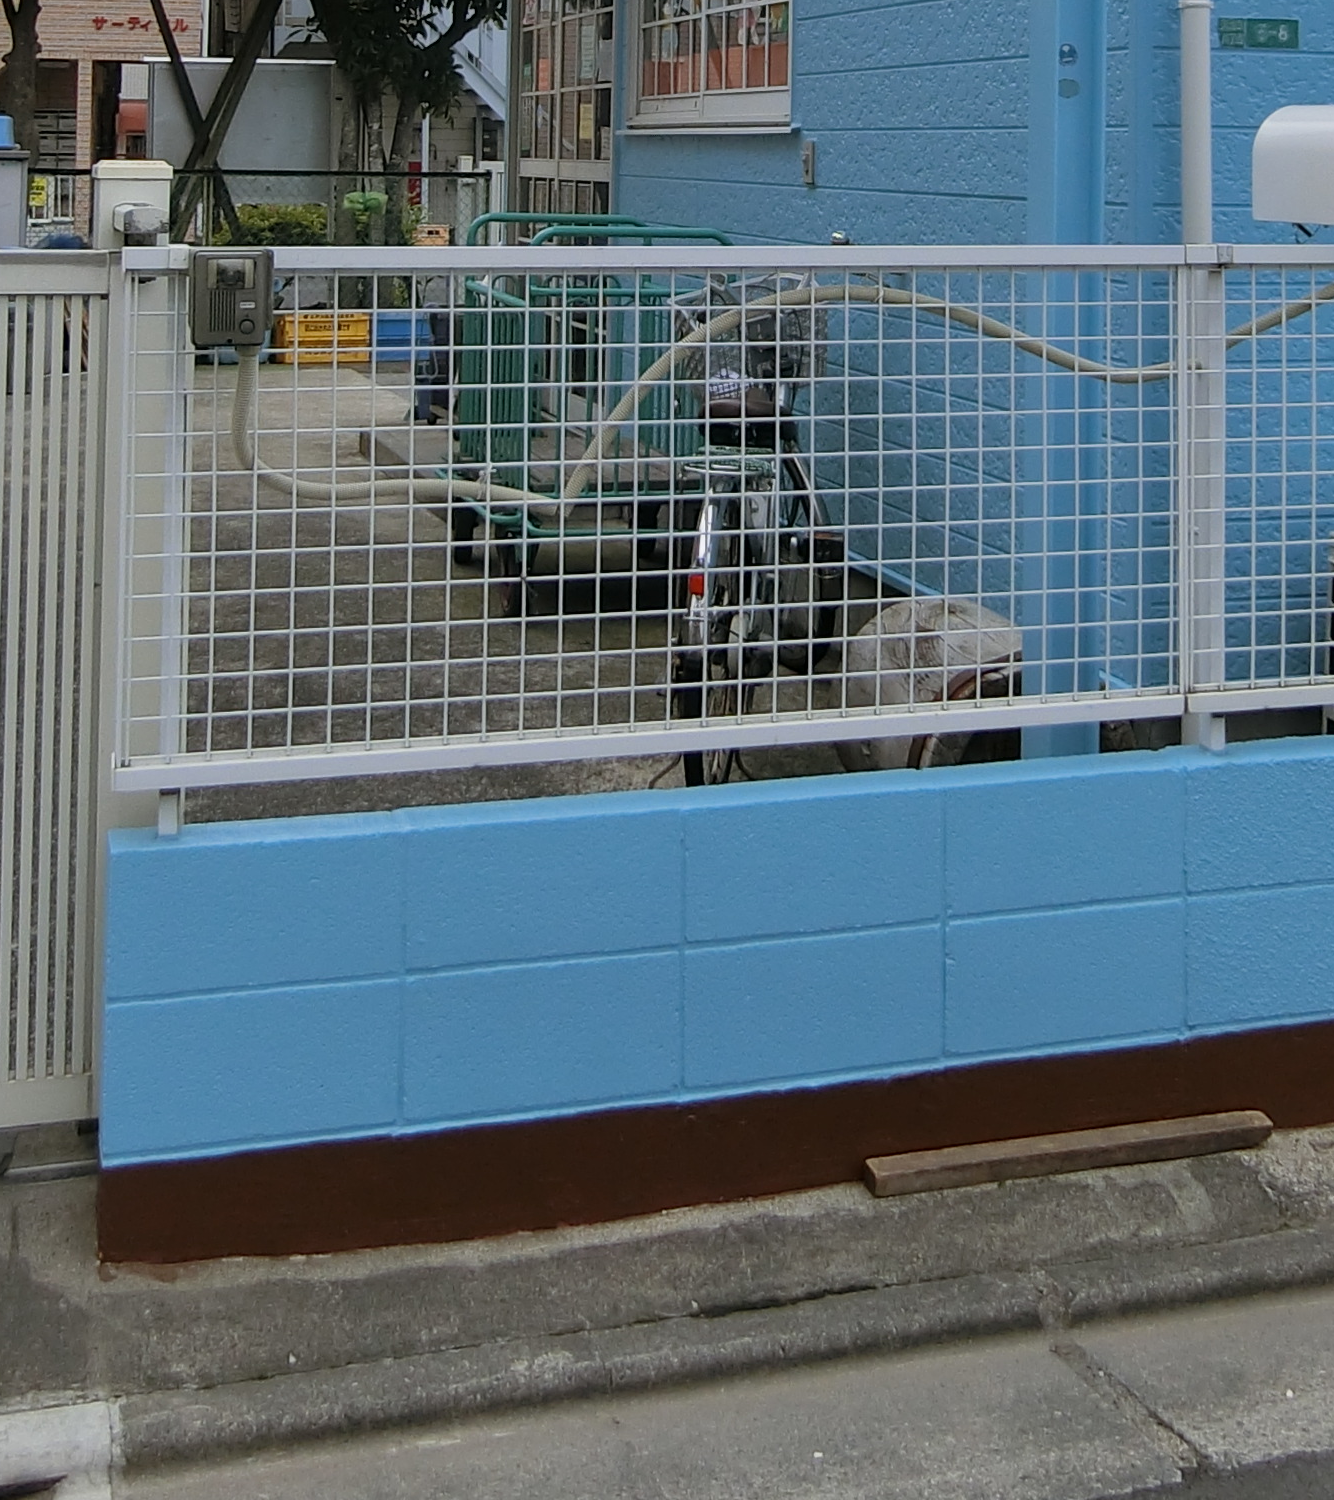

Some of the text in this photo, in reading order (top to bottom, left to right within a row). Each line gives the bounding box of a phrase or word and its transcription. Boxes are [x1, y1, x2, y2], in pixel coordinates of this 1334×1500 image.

[92, 15, 189, 33] サーティル
